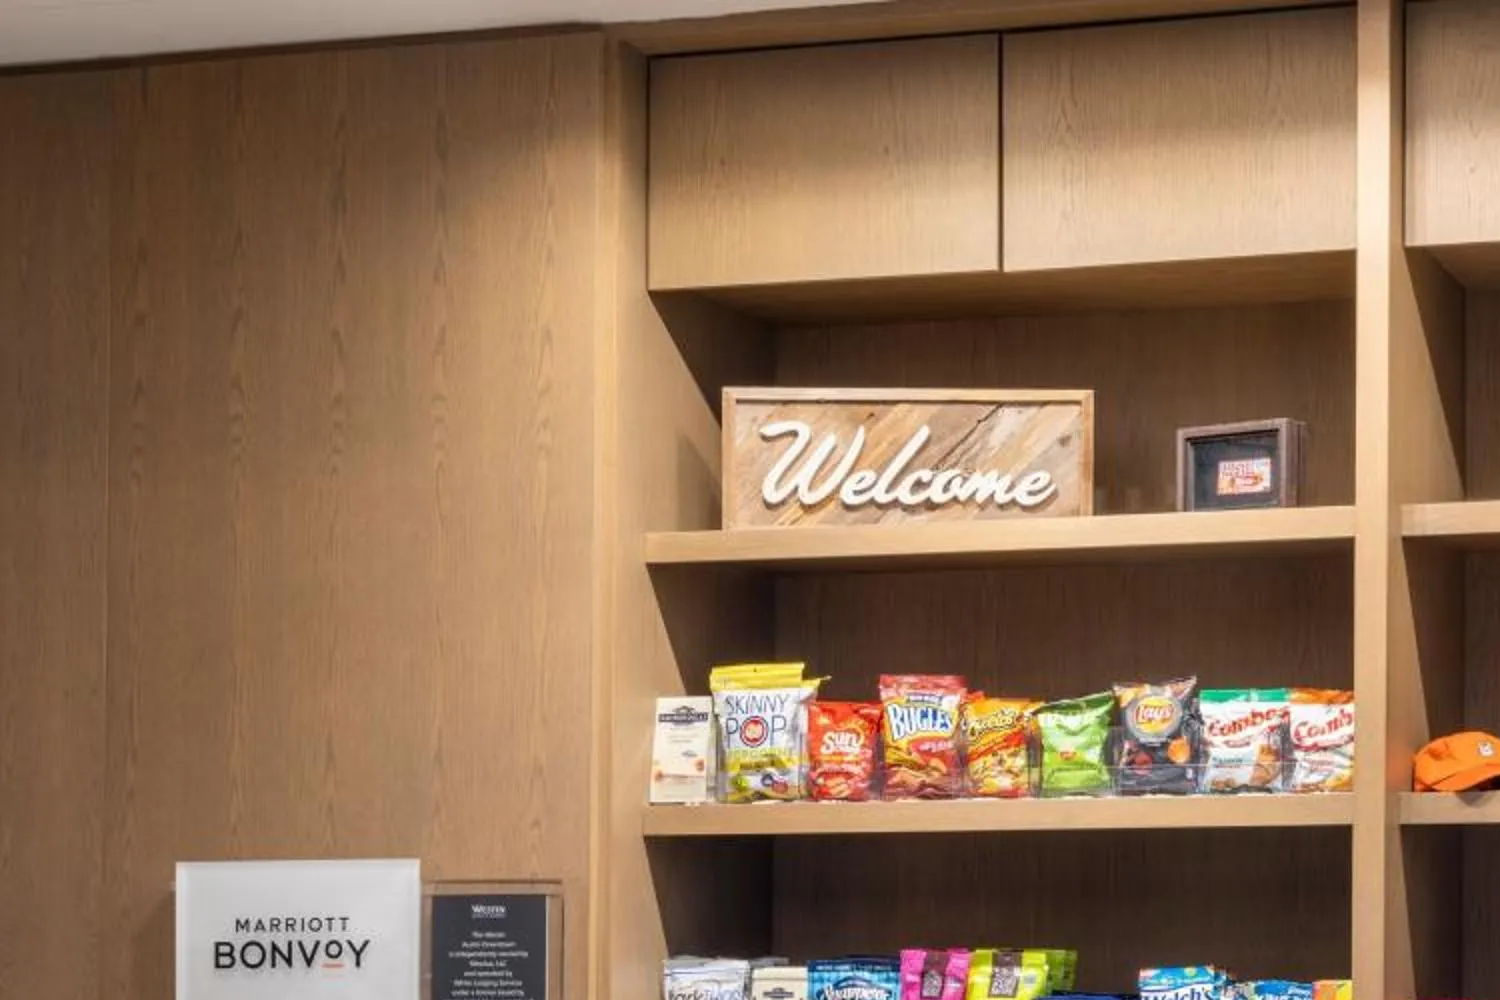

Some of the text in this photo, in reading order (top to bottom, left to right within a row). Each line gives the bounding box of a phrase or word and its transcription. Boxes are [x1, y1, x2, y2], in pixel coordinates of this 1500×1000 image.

[759, 419, 1057, 507] Welcome
[725, 694, 789, 715] SKINNY
[1135, 704, 1174, 723] Lay's
[725, 715, 787, 748] POP
[888, 704, 955, 740] BUGLES
[235, 917, 350, 933] MARRIOTT
[213, 939, 370, 969] BONVOY
